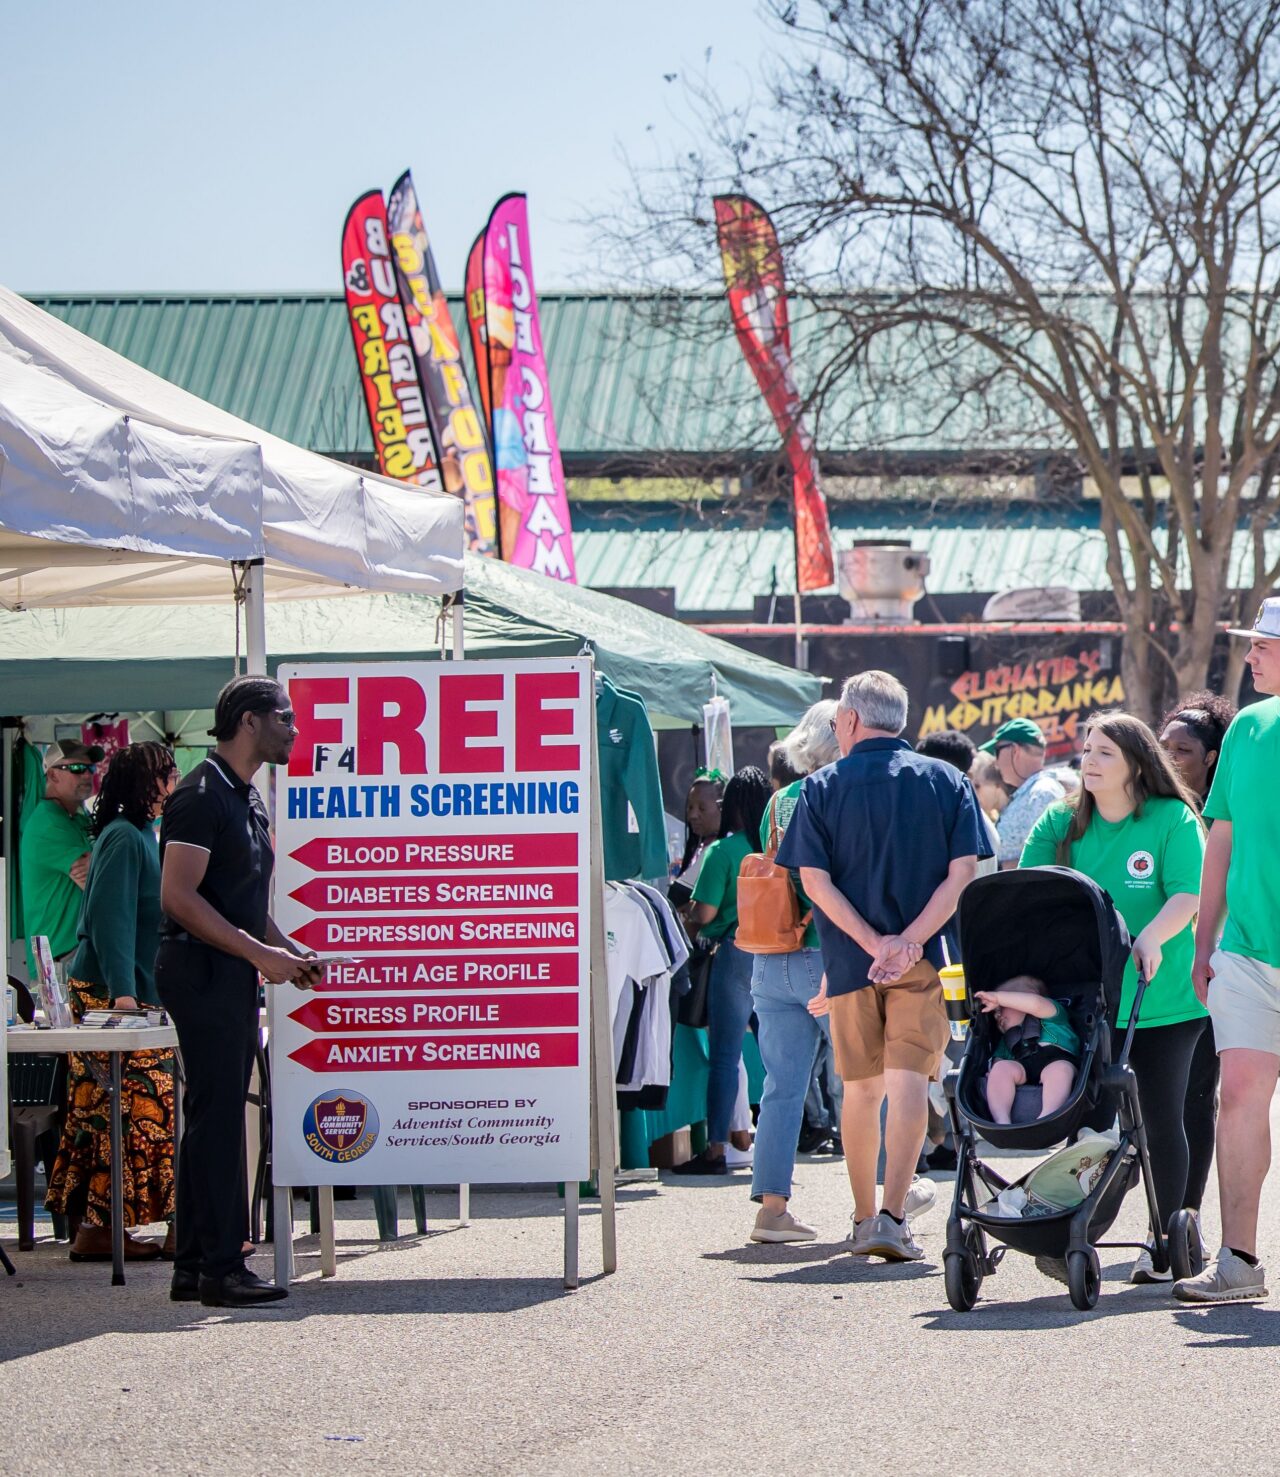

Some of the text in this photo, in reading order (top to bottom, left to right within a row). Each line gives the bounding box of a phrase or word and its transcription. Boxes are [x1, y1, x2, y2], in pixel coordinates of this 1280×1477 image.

[918, 674, 1126, 740] MEDITERRANEA
[287, 672, 580, 777] FREE
[288, 781, 579, 819] HEALTH SCREENING
[327, 844, 514, 864] BLOOD PRESSURE
[327, 883, 553, 904] DIABETES SCREENING
[327, 922, 575, 943] DEPRESSION SCREENING
[326, 962, 550, 984] HEALTH AGE PROFILE
[326, 1004, 499, 1025] STRESS PROFILE
[326, 1042, 540, 1064] ANXIETY SCREENING
[408, 1099, 537, 1110] SPONSORED BY
[392, 1115, 554, 1130] Adventist Community
[306, 1133, 377, 1161] SOUTH GEORGIA
[386, 1132, 560, 1147] Services/South Georgia
